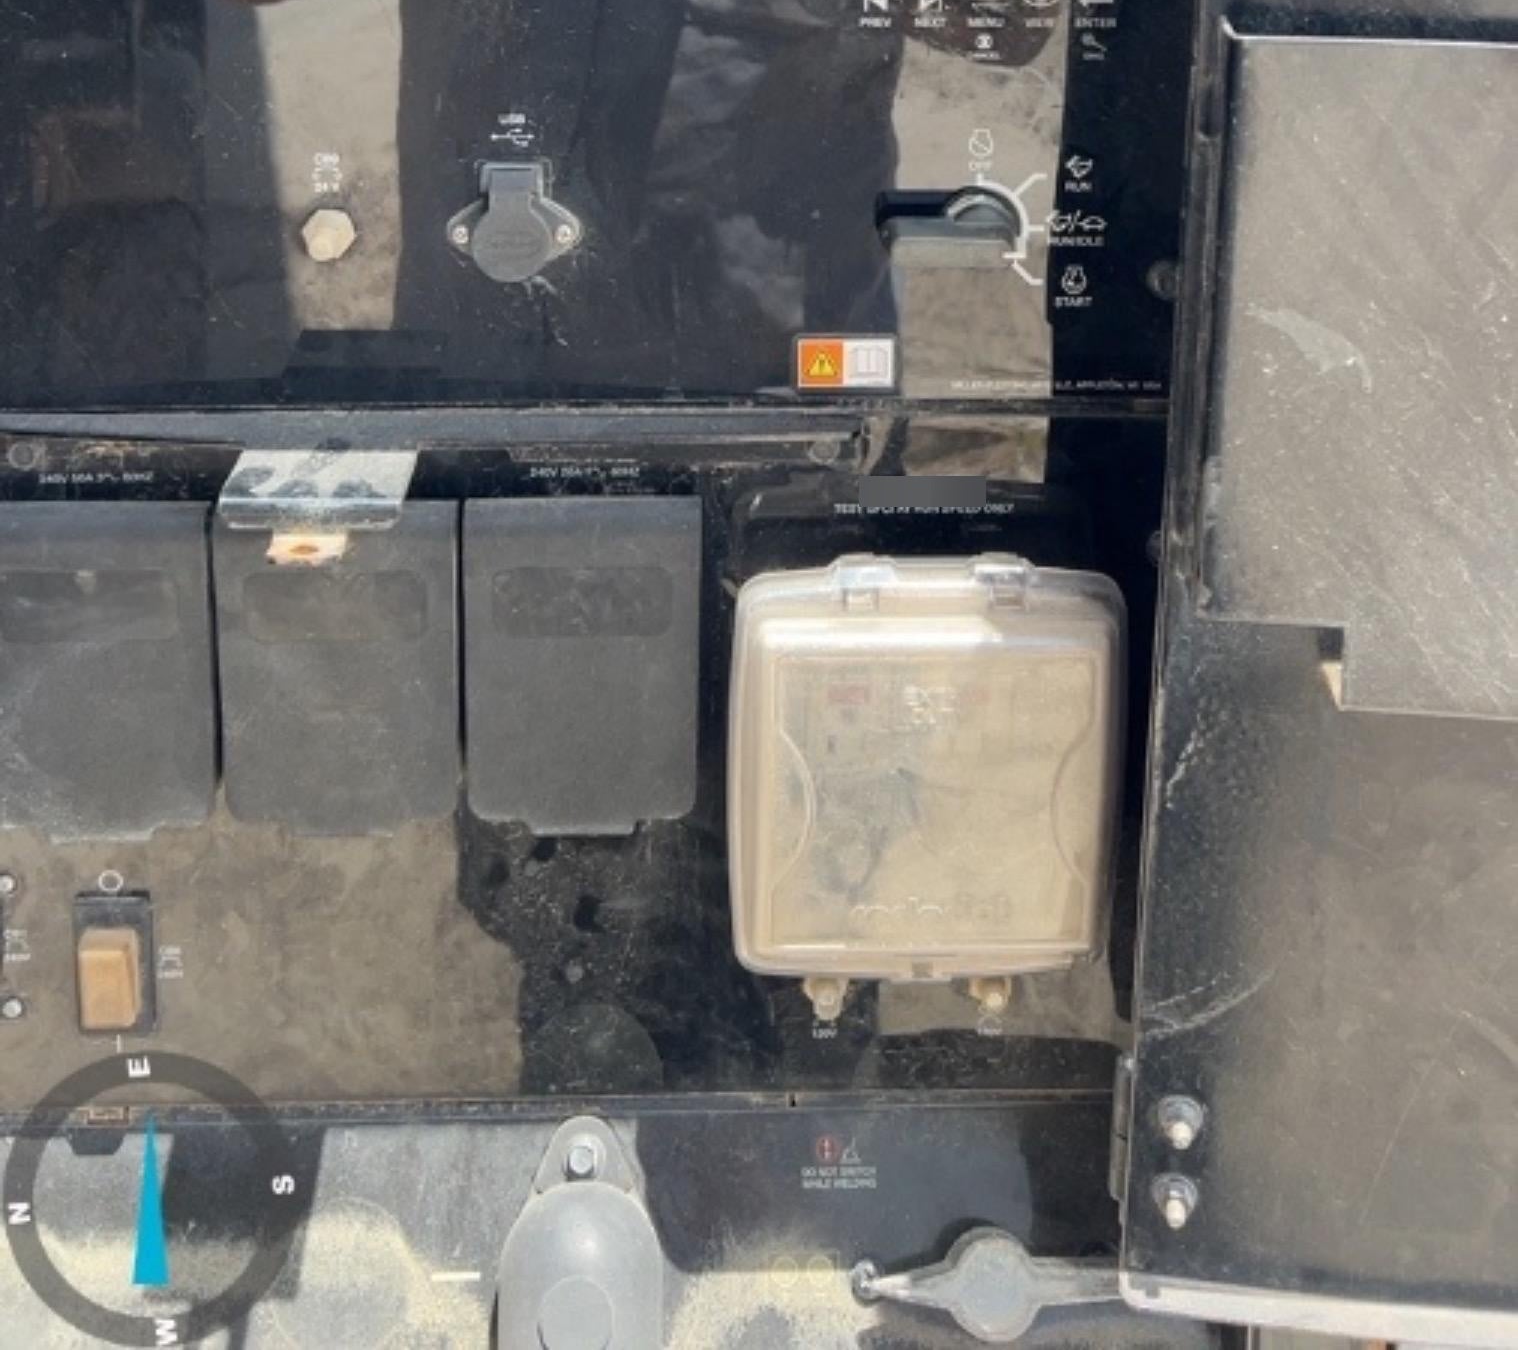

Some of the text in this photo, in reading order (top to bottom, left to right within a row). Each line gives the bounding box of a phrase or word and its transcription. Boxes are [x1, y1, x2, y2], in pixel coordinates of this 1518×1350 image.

[859, 17, 892, 28] PREV
[914, 17, 947, 28] NEXT
[966, 17, 1005, 28] MENU
[1074, 17, 1117, 28] ENTER
[1064, 182, 1092, 192] RUN
[1055, 297, 1092, 308] START
